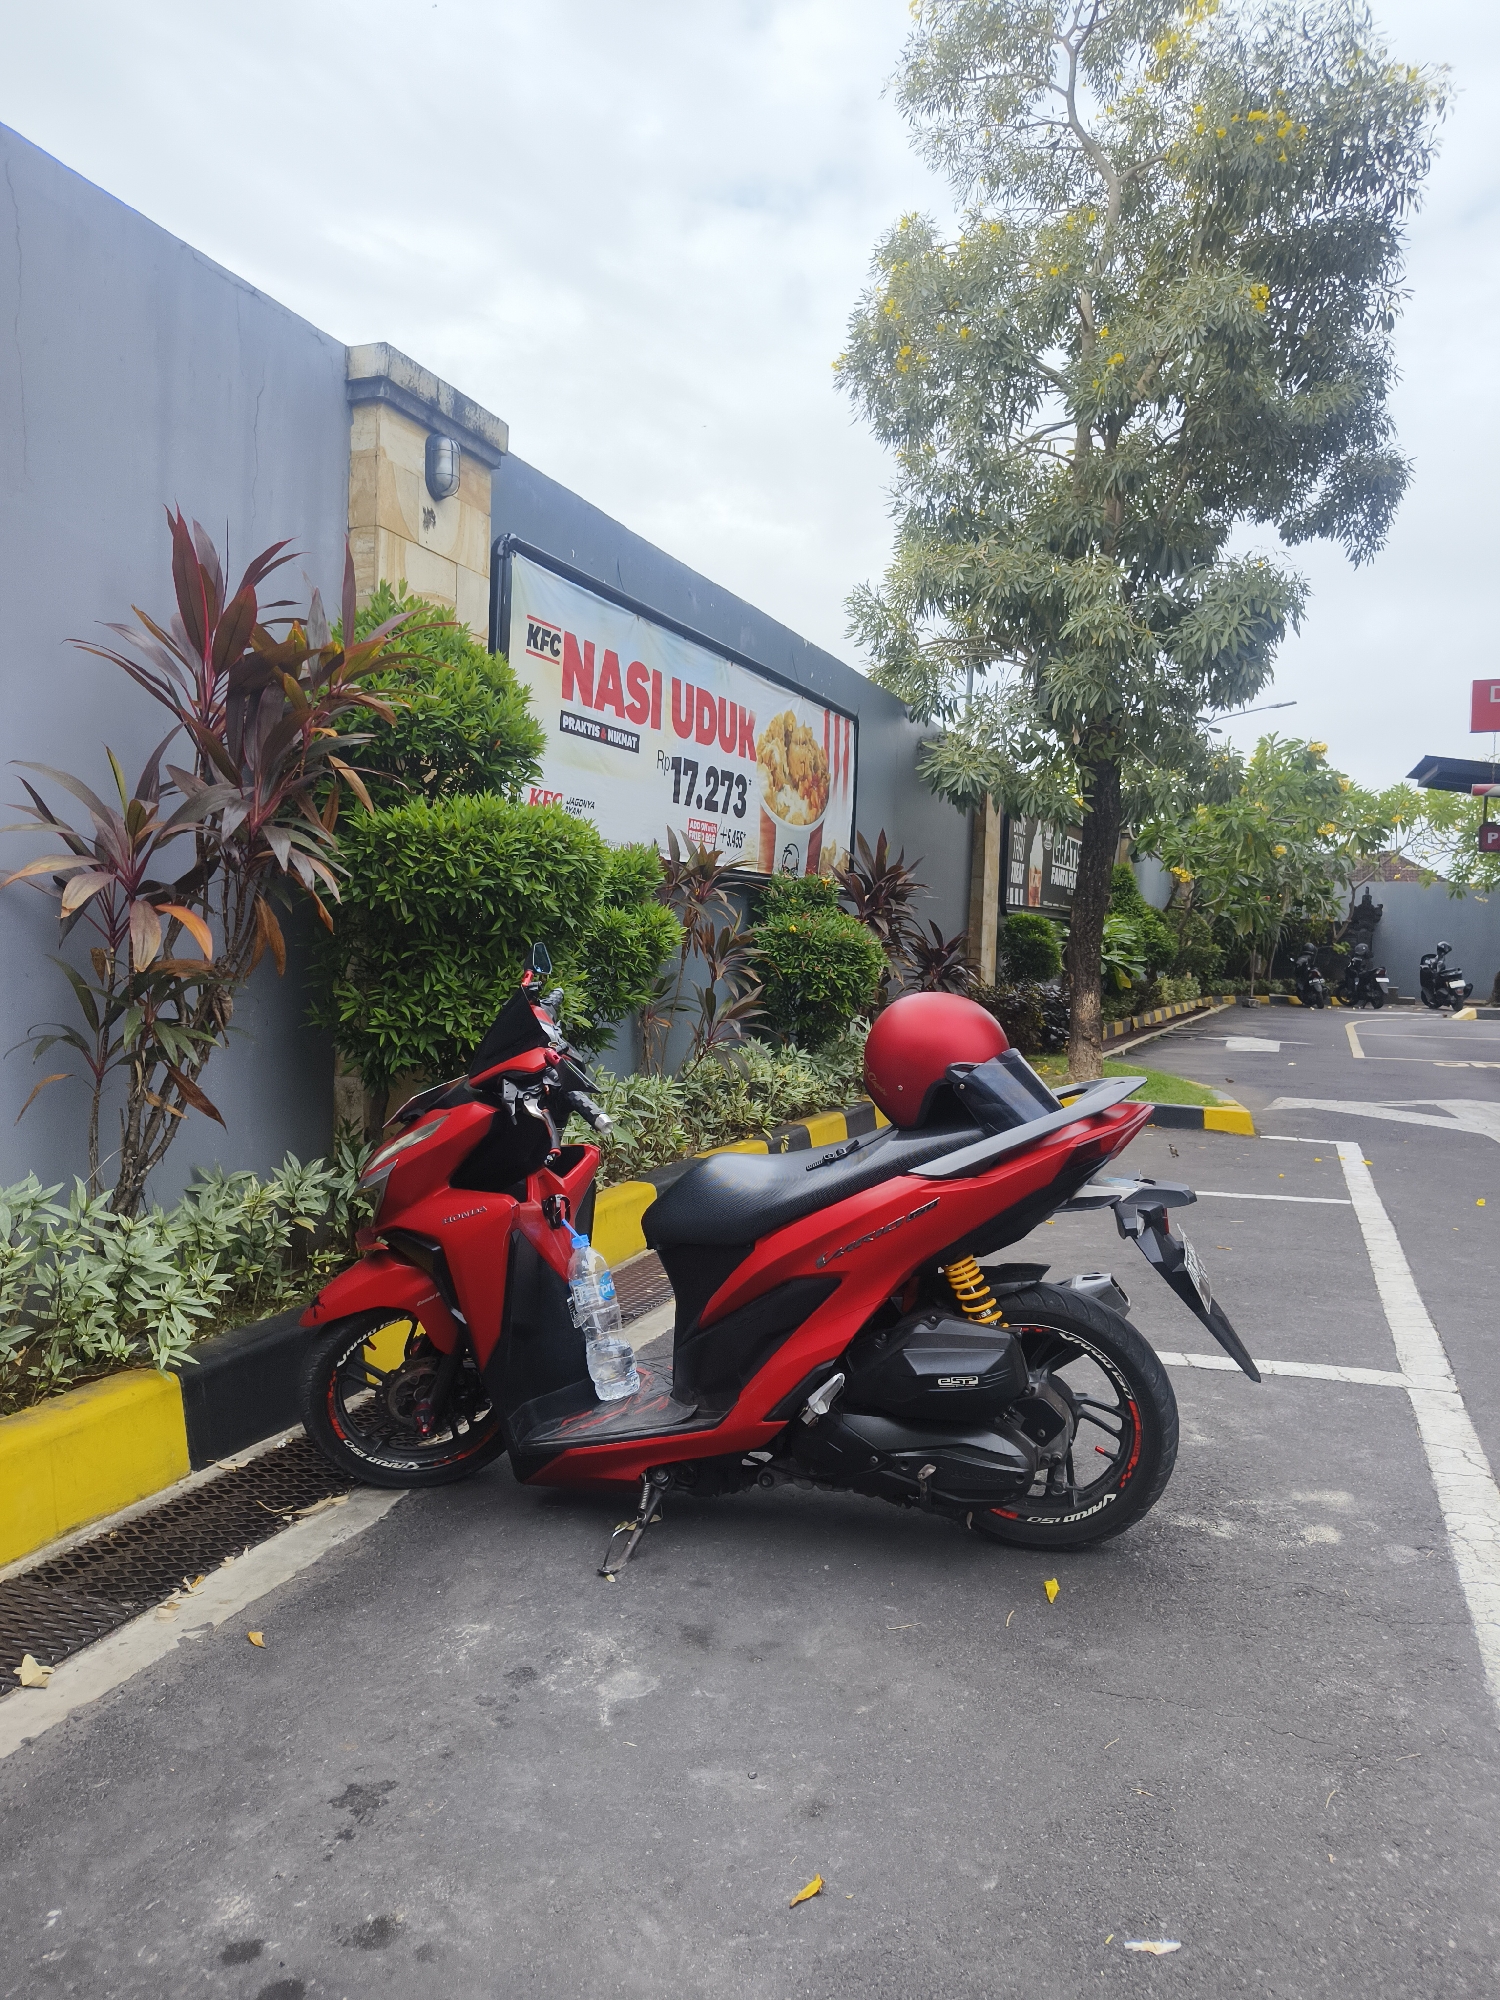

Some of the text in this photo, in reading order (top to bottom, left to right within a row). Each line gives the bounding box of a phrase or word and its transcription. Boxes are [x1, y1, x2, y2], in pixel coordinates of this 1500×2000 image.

[526, 623, 562, 657] KFC
[561, 630, 758, 763] NASI UDUK
[562, 714, 638, 749] PRAKTIS & NIKMAT
[564, 805, 583, 817] AYAM
[566, 797, 596, 810] JAGONYA
[441, 1205, 488, 1225] HONDA
[343, 1439, 368, 1459] 150
[1026, 1493, 1117, 1524] VARIO 150
